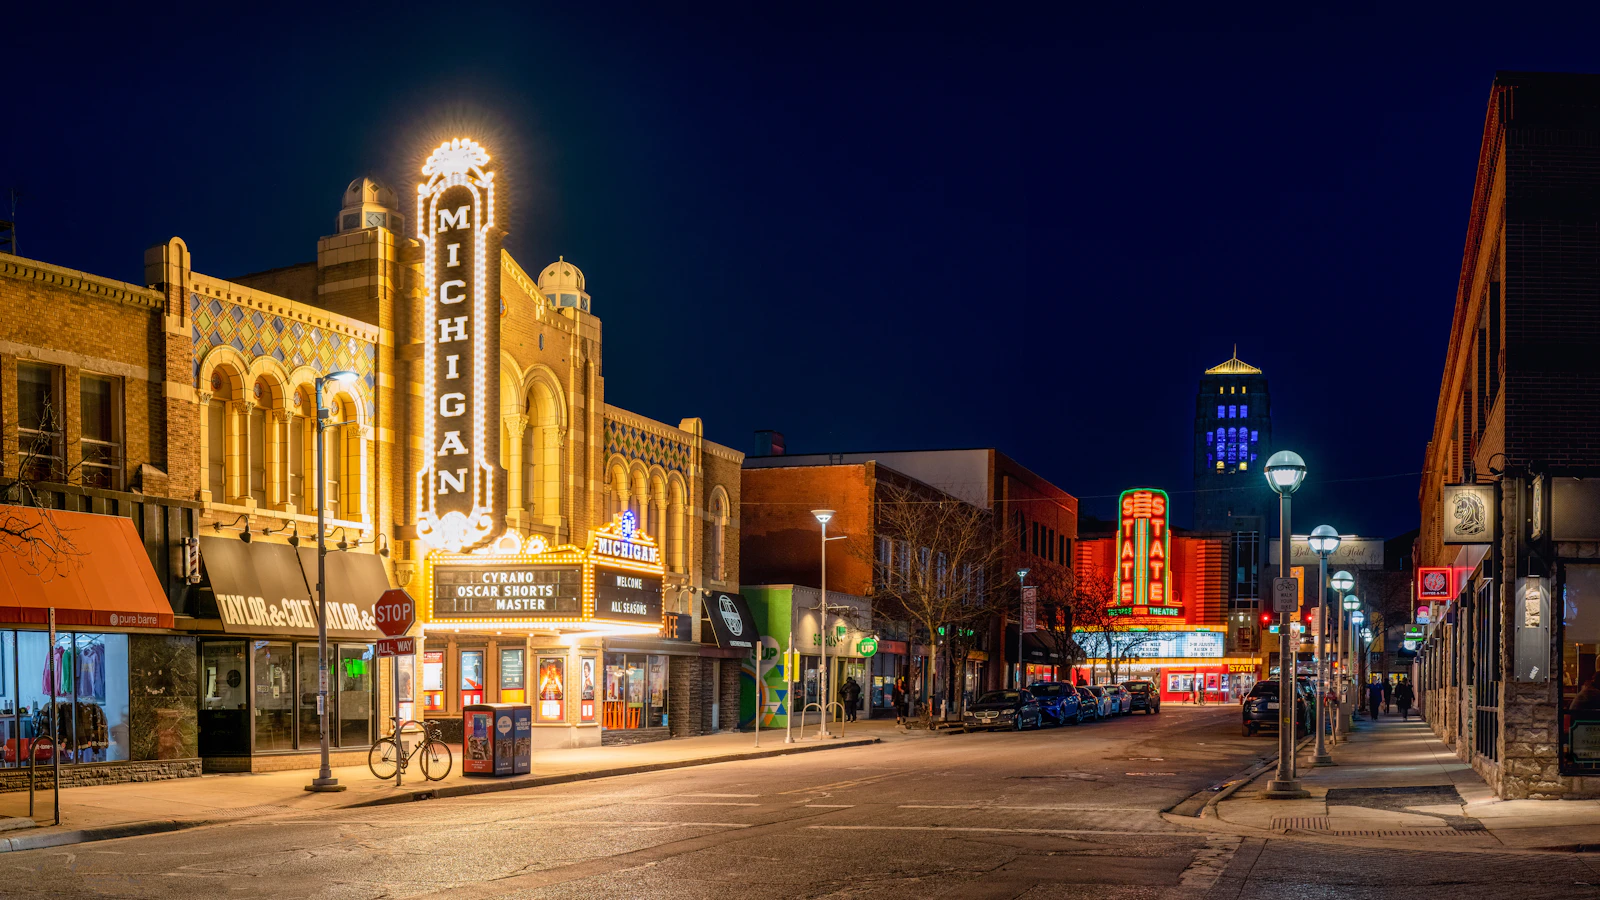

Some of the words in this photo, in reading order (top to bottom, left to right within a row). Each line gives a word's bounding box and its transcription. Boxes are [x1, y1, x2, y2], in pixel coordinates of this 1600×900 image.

[437, 204, 471, 495] MICHIGAN
[598, 537, 656, 562] MICHIGAN
[1122, 497, 1134, 601] STATE
[1150, 497, 1164, 601] STATE
[1340, 545, 1365, 558] Hotel
[482, 572, 533, 583] CYRANO
[617, 576, 642, 589] WELCOME
[457, 586, 498, 597] OSCAR
[504, 585, 553, 597] SHORTS
[496, 599, 545, 610] MASTER
[612, 601, 622, 613] ALL
[623, 601, 647, 615] SEASONS
[377, 604, 411, 623] STOP
[1149, 607, 1178, 616] THEATRE
[119, 615, 136, 625] pure
[137, 614, 157, 624] barre
[378, 644, 392, 654] ALL
[397, 640, 414, 652] WAY
[861, 645, 874, 653] UP
[1229, 664, 1255, 672] STATE
